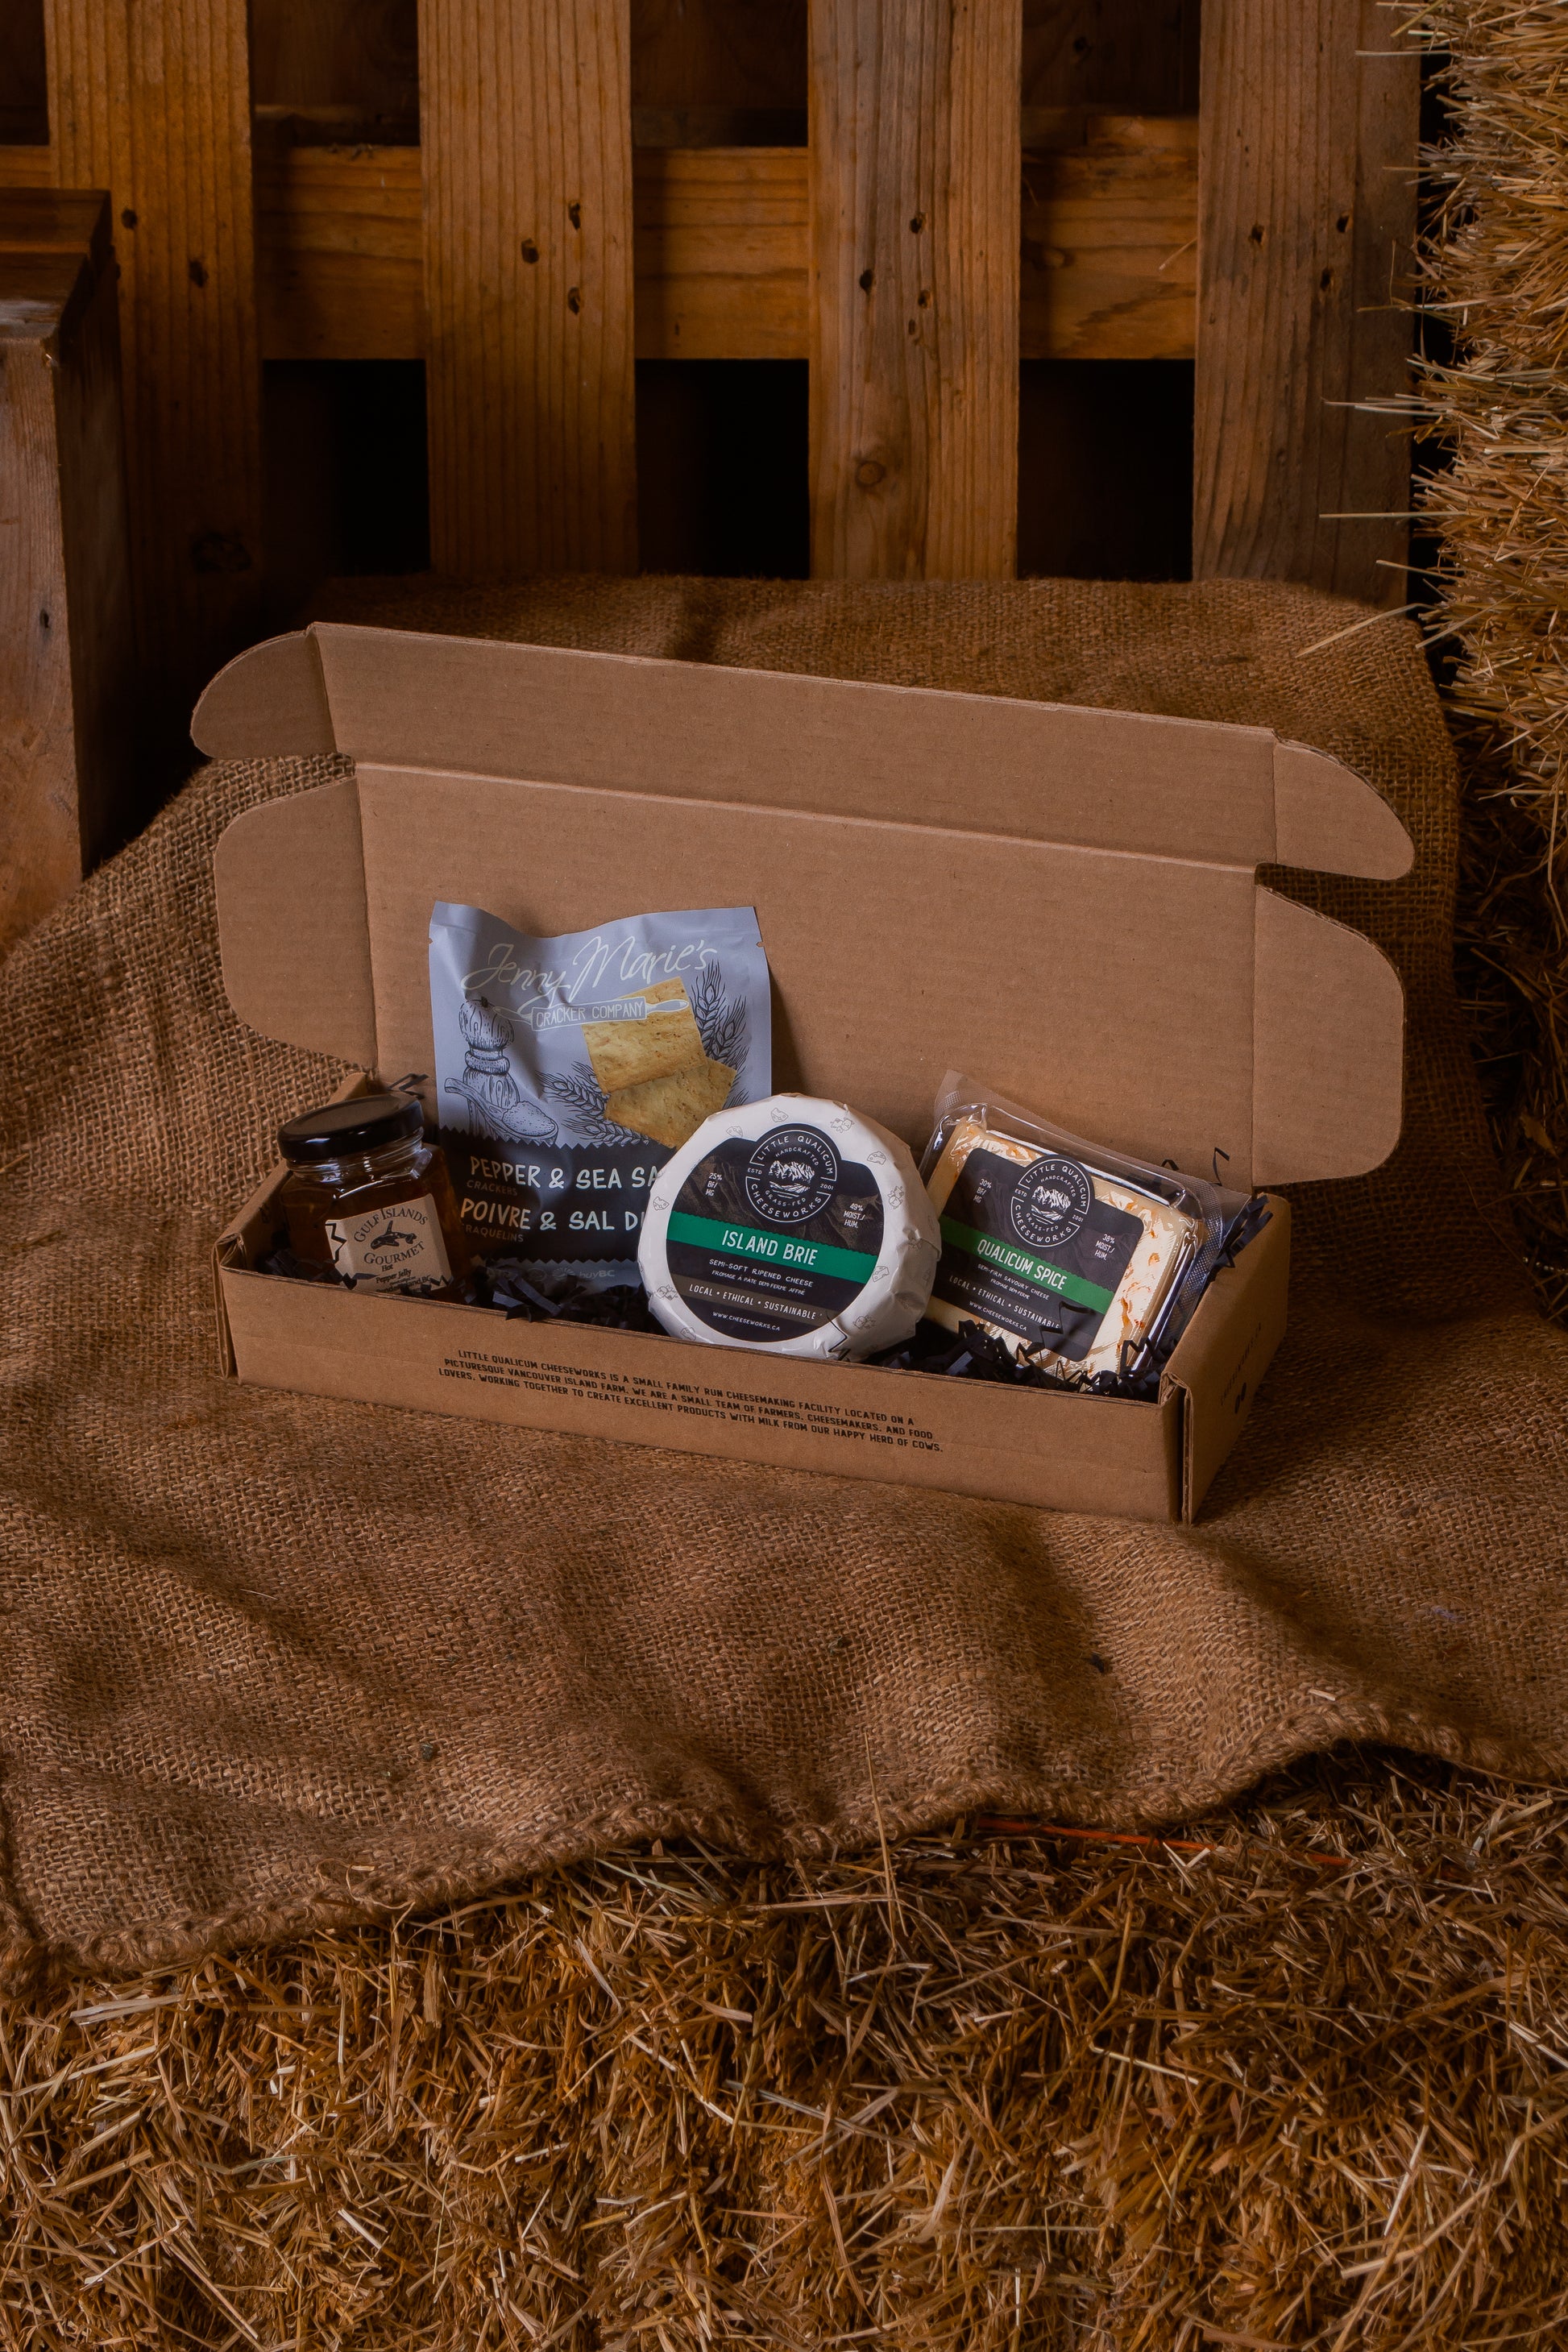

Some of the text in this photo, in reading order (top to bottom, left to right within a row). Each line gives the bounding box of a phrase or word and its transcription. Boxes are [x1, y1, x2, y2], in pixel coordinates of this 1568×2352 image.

[460, 935, 718, 1015] Jenny Marie's
[536, 1003, 645, 1027] CRACKER COMPANY
[757, 1135, 833, 1175] LITTLE QUALICUM
[775, 1147, 819, 1166] HANDCRAFTED
[470, 1155, 658, 1189] PEPPER & SEA SA
[709, 1172, 723, 1180] 25%
[466, 1180, 517, 1196] CRACKERS
[705, 1188, 715, 1197] MG
[707, 1180, 718, 1188] BF/
[976, 1187, 987, 1196] BF/
[979, 1178, 993, 1189] 30%
[1014, 1188, 1027, 1197] ESTD
[1025, 1164, 1087, 1208] LITTLE QUALICUM
[1040, 1175, 1076, 1197] HANDCRAFTED
[751, 1184, 822, 1218] CHEESEWORKS
[765, 1190, 807, 1207] GRASS-FED
[849, 1203, 864, 1212] 49%
[973, 1195, 983, 1204] MG
[354, 1207, 429, 1242] GULF ISLANDS
[460, 1198, 531, 1230] POIVRE
[540, 1211, 557, 1230] &
[569, 1210, 615, 1230] SAL
[844, 1219, 858, 1229] HUM.
[1014, 1205, 1072, 1243] CHEESEWORKS
[1026, 1213, 1059, 1232] GRASS-FED
[1072, 1214, 1084, 1222] 2001
[463, 1223, 524, 1242] RAQUELINS
[1102, 1234, 1115, 1244] 38%
[363, 1241, 425, 1265] GOURMET
[722, 1230, 819, 1266] ISLAND BRIE
[1094, 1250, 1107, 1261] HUM.
[382, 1264, 393, 1272] Hot
[709, 1259, 814, 1288] SEMI-SOFT RIPENED CHEESE
[711, 1270, 736, 1280] FROMAGE
[977, 1238, 1068, 1291] QUALICUM SPICE
[375, 1273, 398, 1284] Pepper
[977, 1263, 1050, 1300] SEMI-FIRM SAVOURY CHEESE
[949, 1275, 970, 1290] LOCAL
[977, 1288, 1006, 1307] ETHICAL
[689, 1284, 816, 1320] LOCAL ETHICAL SUSTAINABLE
[712, 1311, 781, 1331] WWW.CHEESEWORKS.CA
[969, 1300, 1027, 1331] WWW.CHEESEWORKS.CA
[458, 1350, 915, 1426] LITTLE QUALICUM CHEESEWORKS IS A SMALL FAMILY RUN CHEESEMAKING FACILITY LOCATED ON A
[444, 1358, 505, 1375] PICTURESQUE
[508, 1368, 562, 1383] VANCOUVER
[565, 1376, 598, 1389] ISLAND
[633, 1388, 647, 1397] WE
[650, 1390, 668, 1400] ARE
[671, 1393, 678, 1402] A
[681, 1395, 712, 1407] SMALL
[716, 1400, 740, 1411] TEAM
[744, 1404, 756, 1413] OF
[886, 1425, 906, 1435] AND
[909, 1429, 933, 1440] FOOD
[479, 1373, 520, 1388] WORKING
[523, 1380, 569, 1395] TOGETHER
[572, 1388, 584, 1398] TO
[587, 1391, 621, 1404] CREATE
[624, 1396, 674, 1412] EXCELLENT
[678, 1405, 726, 1419] PRODUCTS
[729, 1412, 755, 1424] WITH
[759, 1417, 780, 1428] MILK
[783, 1421, 808, 1432] FROM
[811, 1425, 829, 1435] OUR
[834, 1428, 865, 1440] HAPPY
[870, 1433, 894, 1445] HERD
[897, 1438, 909, 1447] OF
